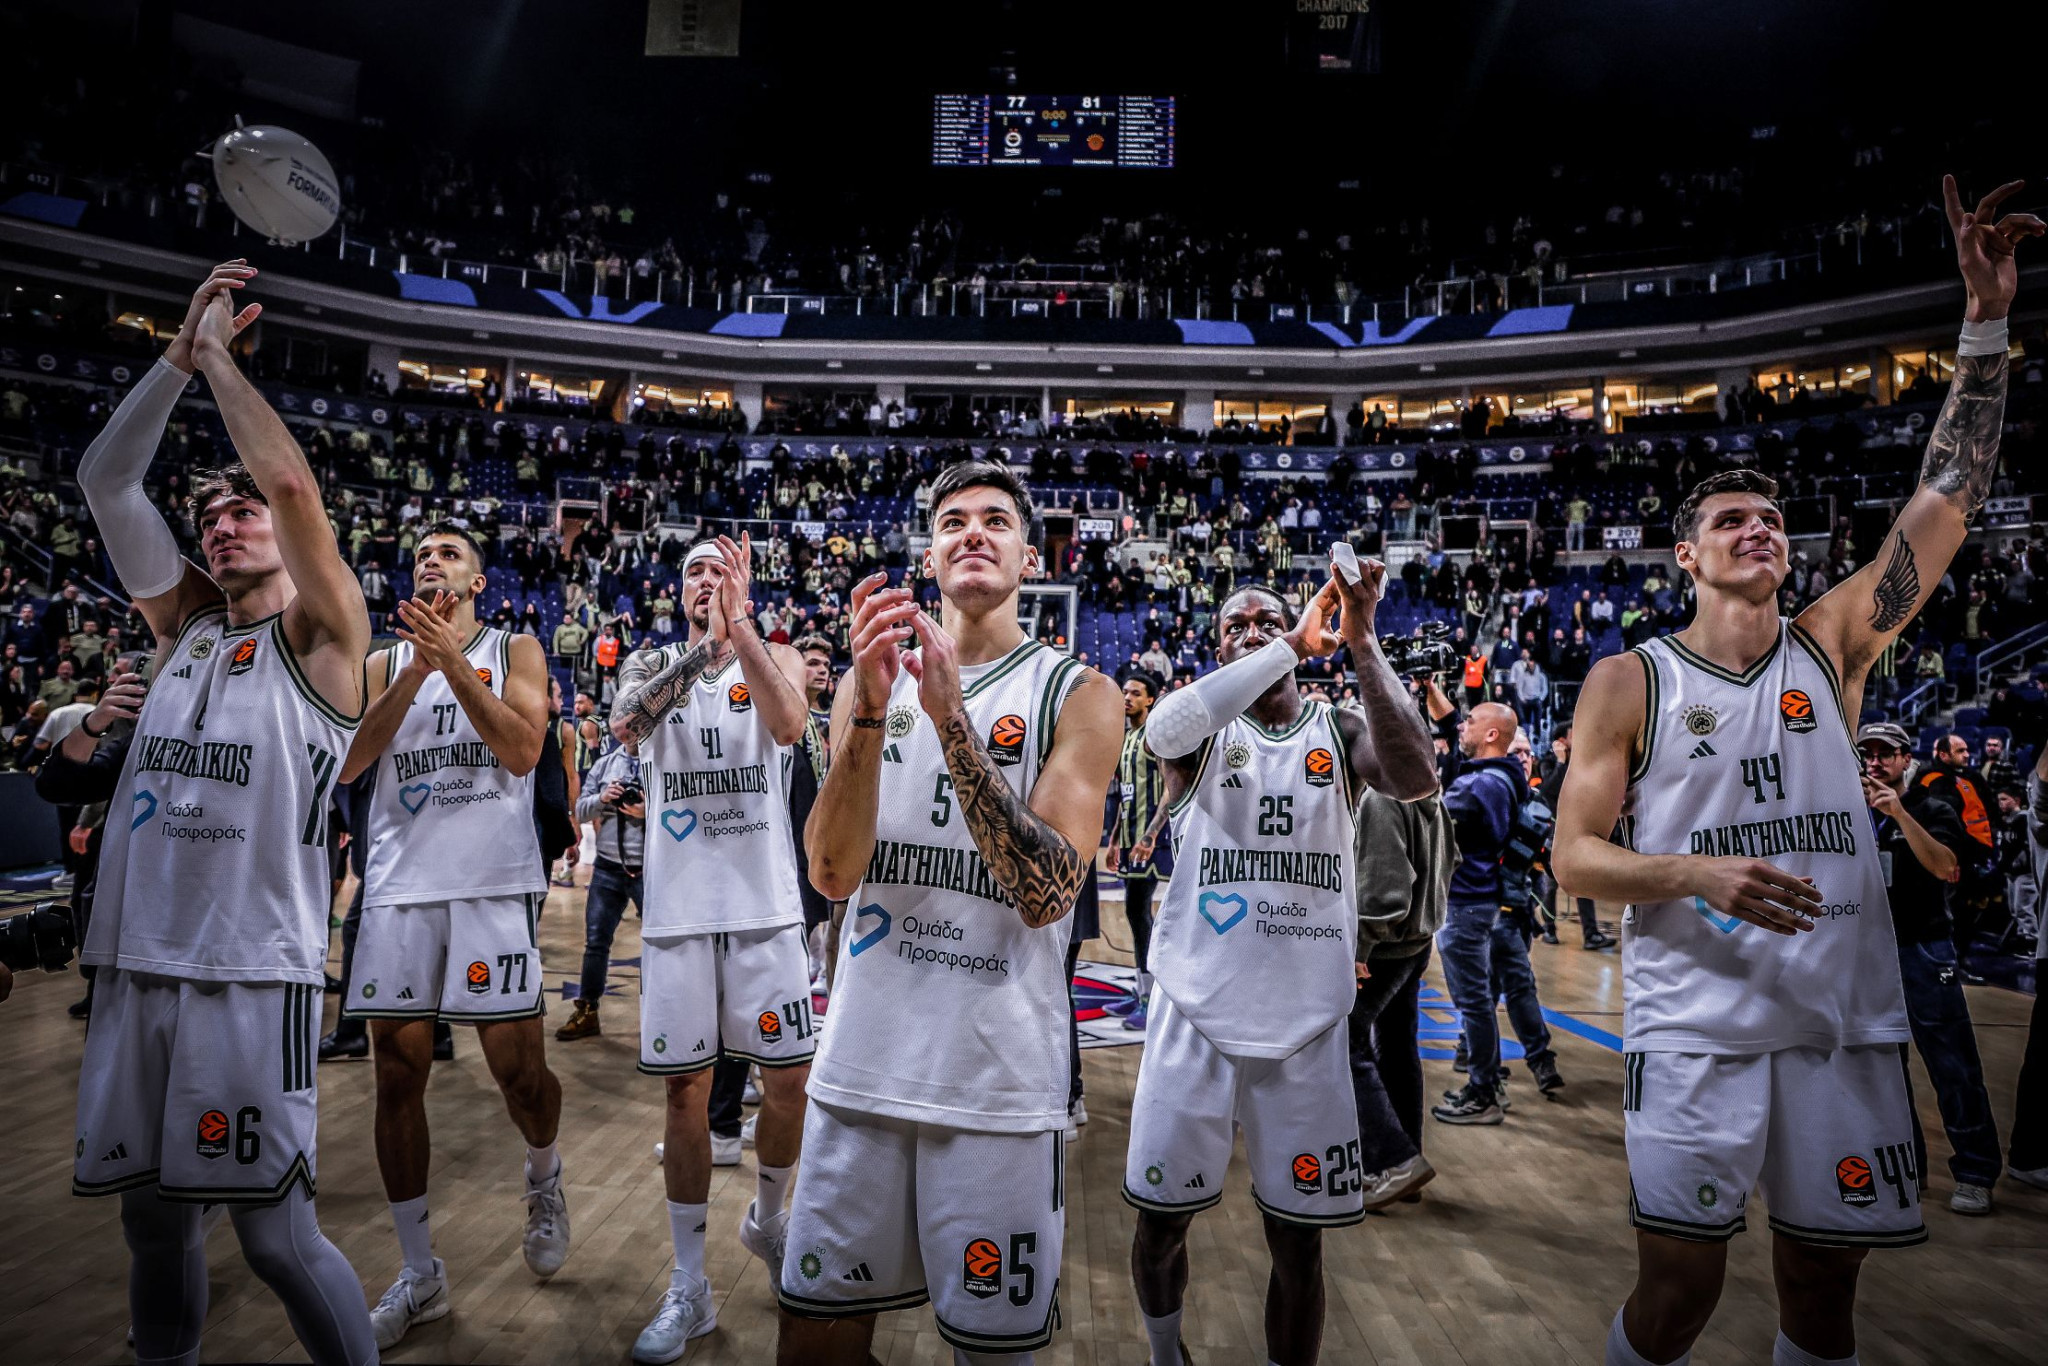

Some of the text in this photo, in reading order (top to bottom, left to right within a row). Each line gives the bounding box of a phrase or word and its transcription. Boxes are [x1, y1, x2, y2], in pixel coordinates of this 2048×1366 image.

[1297, 0, 1369, 13] CHAMPIONS
[1319, 15, 1348, 29] 2017
[1007, 96, 1027, 108] 77
[1041, 110, 1067, 120] 0:00
[1082, 96, 1100, 108] 81
[27, 173, 50, 186] 412
[1618, 540, 1640, 549] 107
[433, 703, 457, 736] 77
[700, 727, 723, 760] 41
[433, 779, 473, 793] Ομάδα
[663, 764, 768, 803] PANATHINAIKOS
[1740, 753, 1786, 804] 44
[432, 790, 500, 808] Προσφοράς
[930, 773, 954, 828] 5
[1258, 795, 1293, 836] 25
[703, 809, 744, 824] Ομάδα
[704, 820, 769, 839] Προσφοράς
[1691, 812, 1856, 858] PANATHINAIKOS
[1199, 847, 1342, 893] PANATHINAIKOS
[1257, 901, 1308, 918] Ομάδα
[903, 917, 964, 941] Ομάδα
[1255, 920, 1343, 941] Προσφοράς
[497, 953, 527, 994] 77
[899, 940, 1009, 976] Προσφοράς
[782, 997, 813, 1040] 41
[235, 1106, 262, 1165] 6
[1325, 1138, 1362, 1197] 25
[1873, 1141, 1920, 1209] 44
[1008, 1231, 1037, 1307] 5
